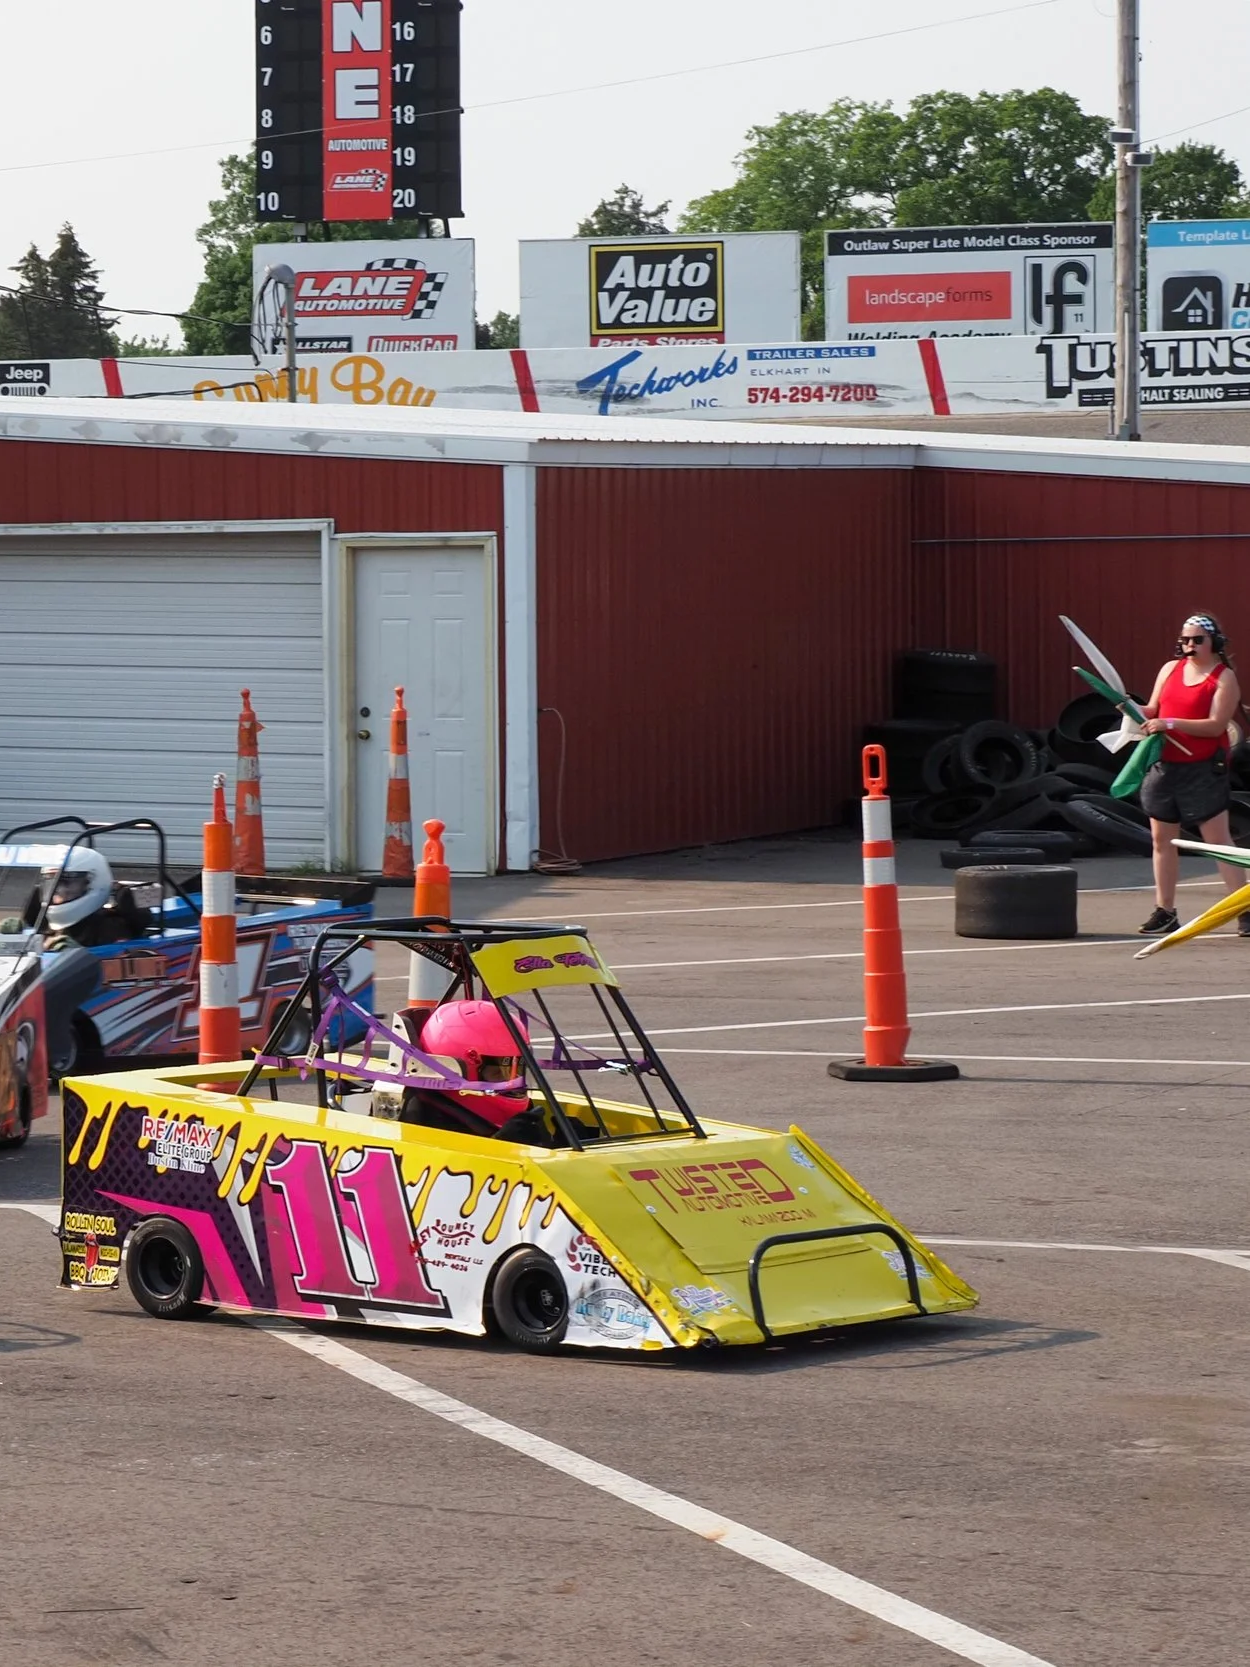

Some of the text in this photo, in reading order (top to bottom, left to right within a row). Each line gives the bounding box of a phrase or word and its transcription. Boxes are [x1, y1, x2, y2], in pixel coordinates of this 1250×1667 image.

[260, 26, 272, 45] 6
[392, 22, 415, 41] 16
[261, 68, 273, 86] 7
[392, 64, 415, 82] 17
[261, 109, 273, 128] 8
[393, 105, 415, 124] 18
[328, 138, 388, 151] AUTOMOTIVE
[261, 151, 273, 169] 9
[393, 147, 416, 166] 19
[257, 192, 279, 211] 10
[392, 189, 416, 208] 20
[844, 233, 1096, 253] Outlaw Super Late Model Class Sponsor
[1178, 231, 1238, 244] Template
[602, 255, 710, 289] Auto
[297, 276, 415, 296] LANE
[294, 298, 406, 311] AUTOMOTIVE
[598, 290, 716, 324] Value
[295, 340, 348, 350] LLSTAR
[754, 347, 869, 359] TRAILER SALES
[751, 367, 831, 376] ELKHART IN
[1038, 336, 1250, 392] TUTINS
[5, 366, 44, 382] Jeep
[576, 350, 739, 415] Techworks
[748, 384, 877, 404] 574-294-7200
[1141, 388, 1224, 402] HALT SEALING
[143, 1118, 212, 1147] RE/MAX
[157, 1142, 213, 1162] ELITE GROUP
[628, 1159, 796, 1214] TWISTED
[681, 1190, 772, 1213] AUTOMOTIVE
[65, 1213, 116, 1236] ROLLIN SOUL
[265, 1141, 448, 1312] 11
[436, 1219, 475, 1233] BOUNCY
[437, 1237, 471, 1248] HOUSE
[70, 1262, 86, 1283] BBQ
[583, 1264, 617, 1278] TECH
